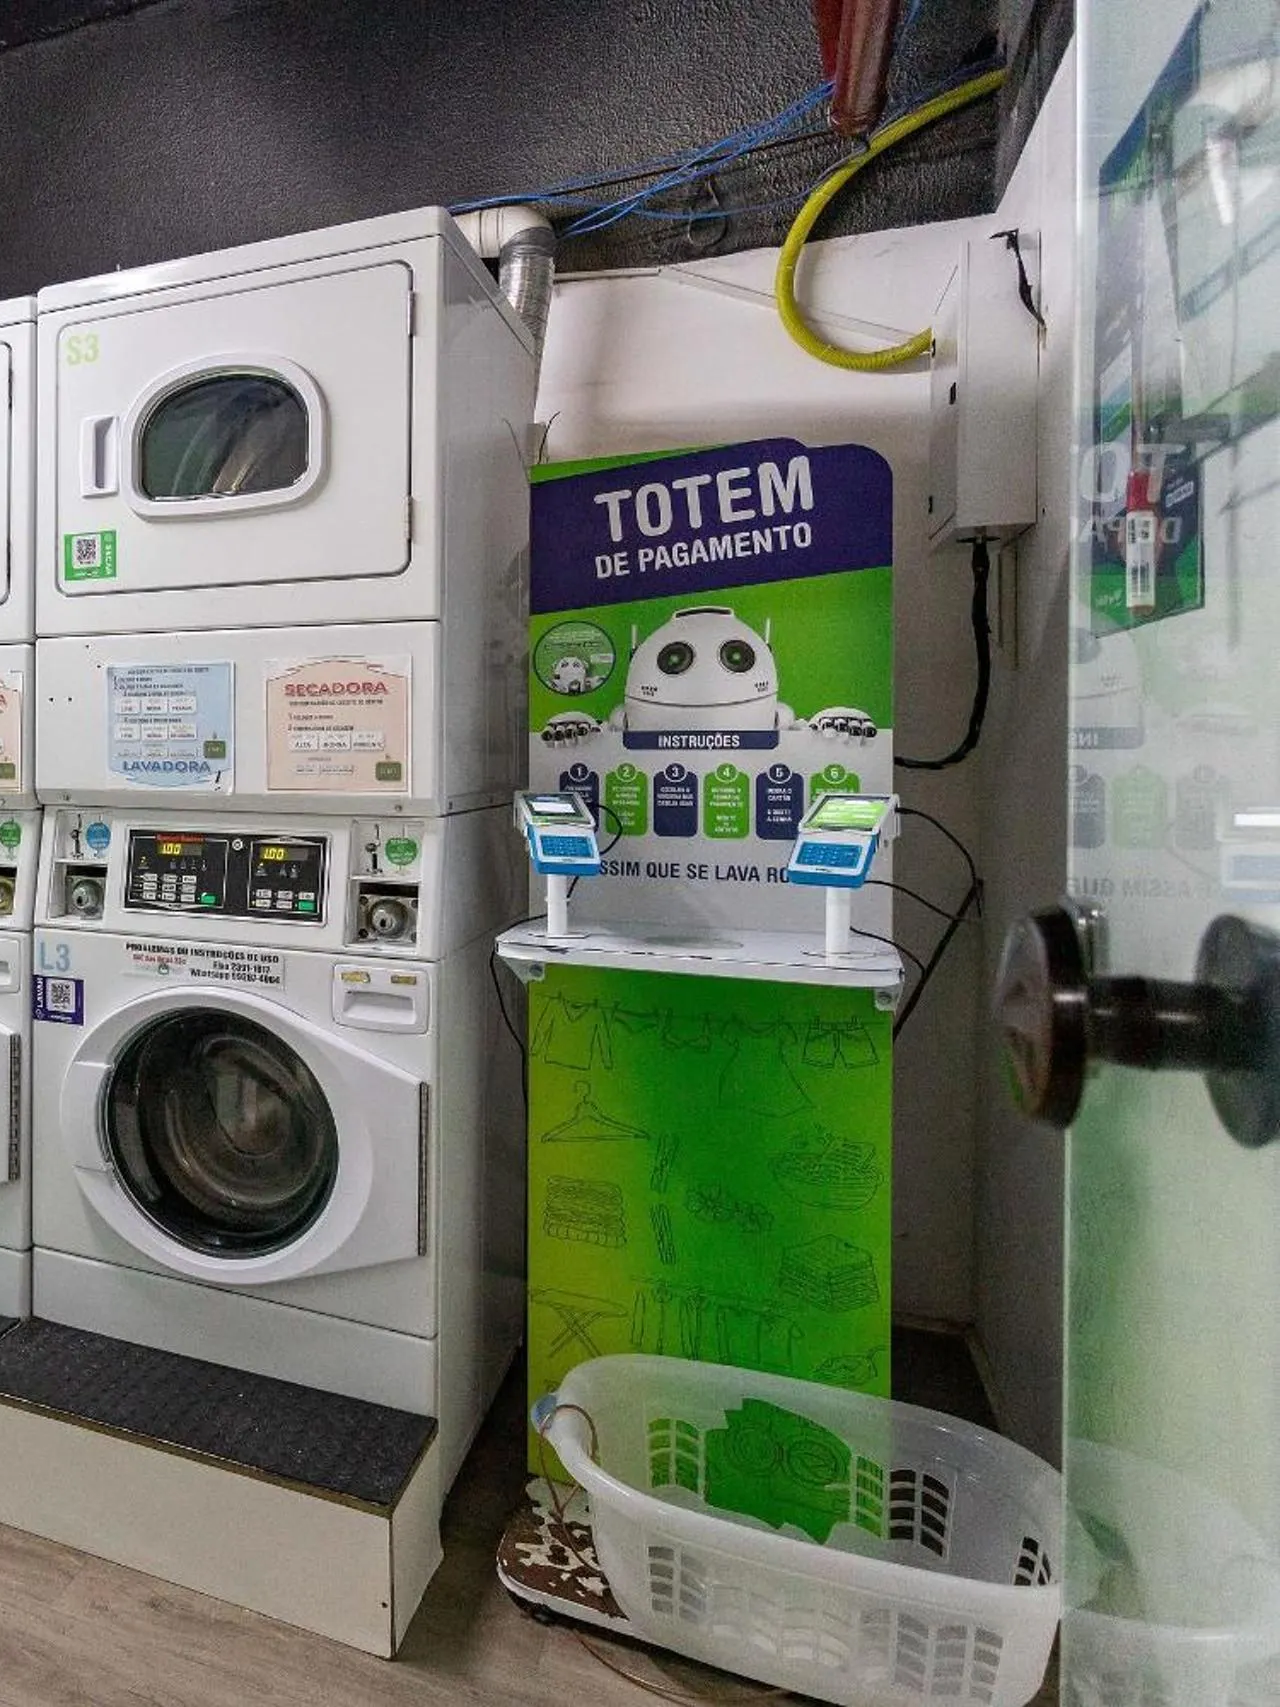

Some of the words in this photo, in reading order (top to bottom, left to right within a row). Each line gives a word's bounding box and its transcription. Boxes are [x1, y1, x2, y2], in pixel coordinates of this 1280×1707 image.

[67, 334, 99, 365] S3
[593, 455, 814, 542] TOTEM
[595, 552, 630, 579] DE
[638, 522, 812, 573] PAGAMENTO
[285, 682, 389, 697] SECADORA
[658, 734, 740, 750] INSTRUÇÕES
[123, 761, 211, 773] LAVADORA
[600, 860, 640, 876] SSIM
[646, 862, 680, 878] QUE
[687, 863, 709, 880] SE
[715, 864, 760, 882] LAVA
[767, 867, 789, 884] RO
[40, 942, 70, 972] L3
[261, 954, 279, 963] USO
